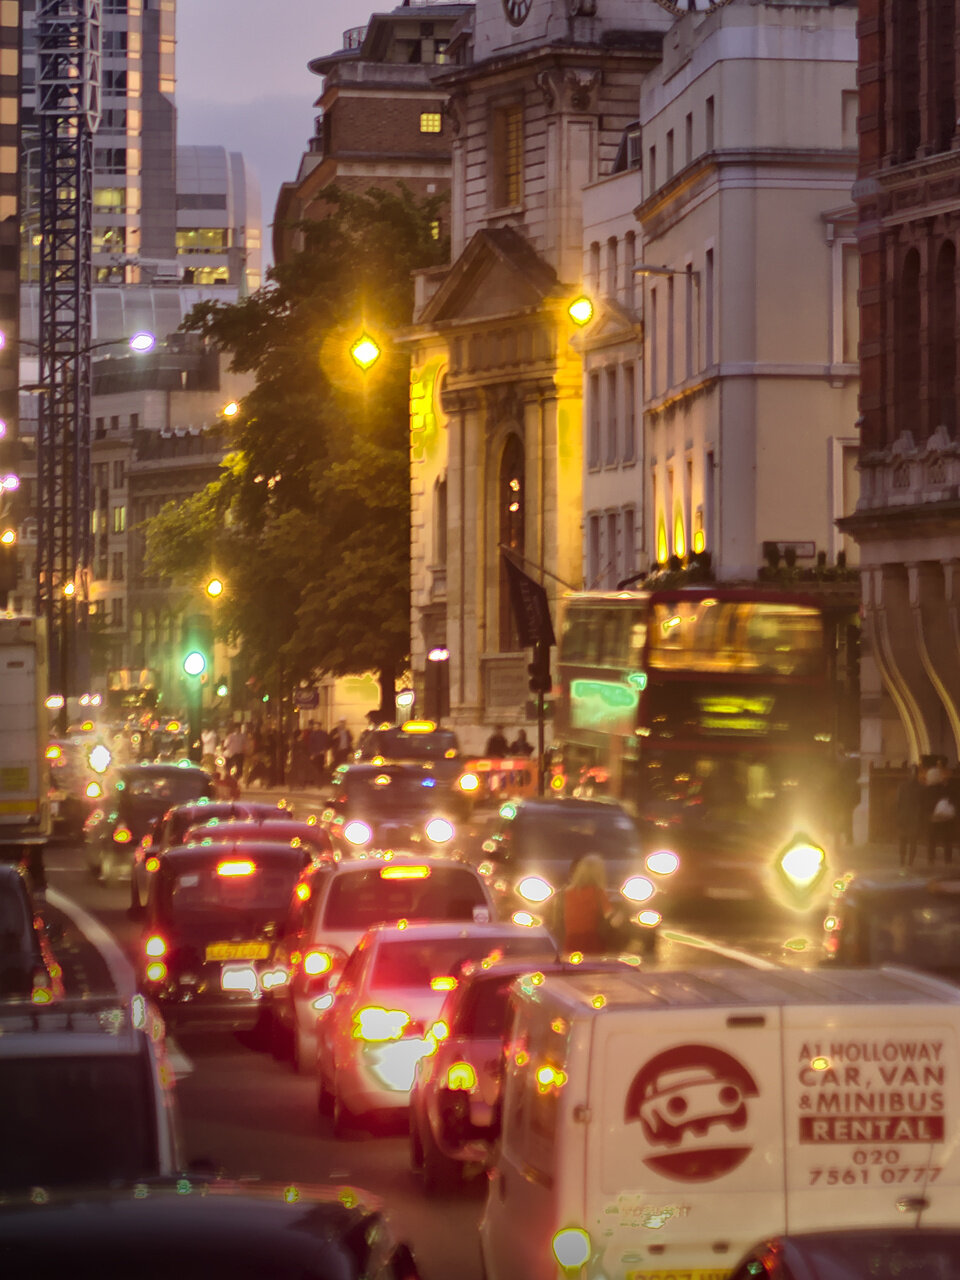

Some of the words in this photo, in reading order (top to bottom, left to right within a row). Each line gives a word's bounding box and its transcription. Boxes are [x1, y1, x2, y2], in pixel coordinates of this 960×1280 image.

[830, 1042, 943, 1062] HOLLOWAY
[878, 1066, 945, 1087] VAN
[812, 1120, 931, 1140] RENTAL
[852, 1149, 900, 1165] 020
[809, 1169, 869, 1186] 7561
[881, 1167, 943, 1184] 0777
